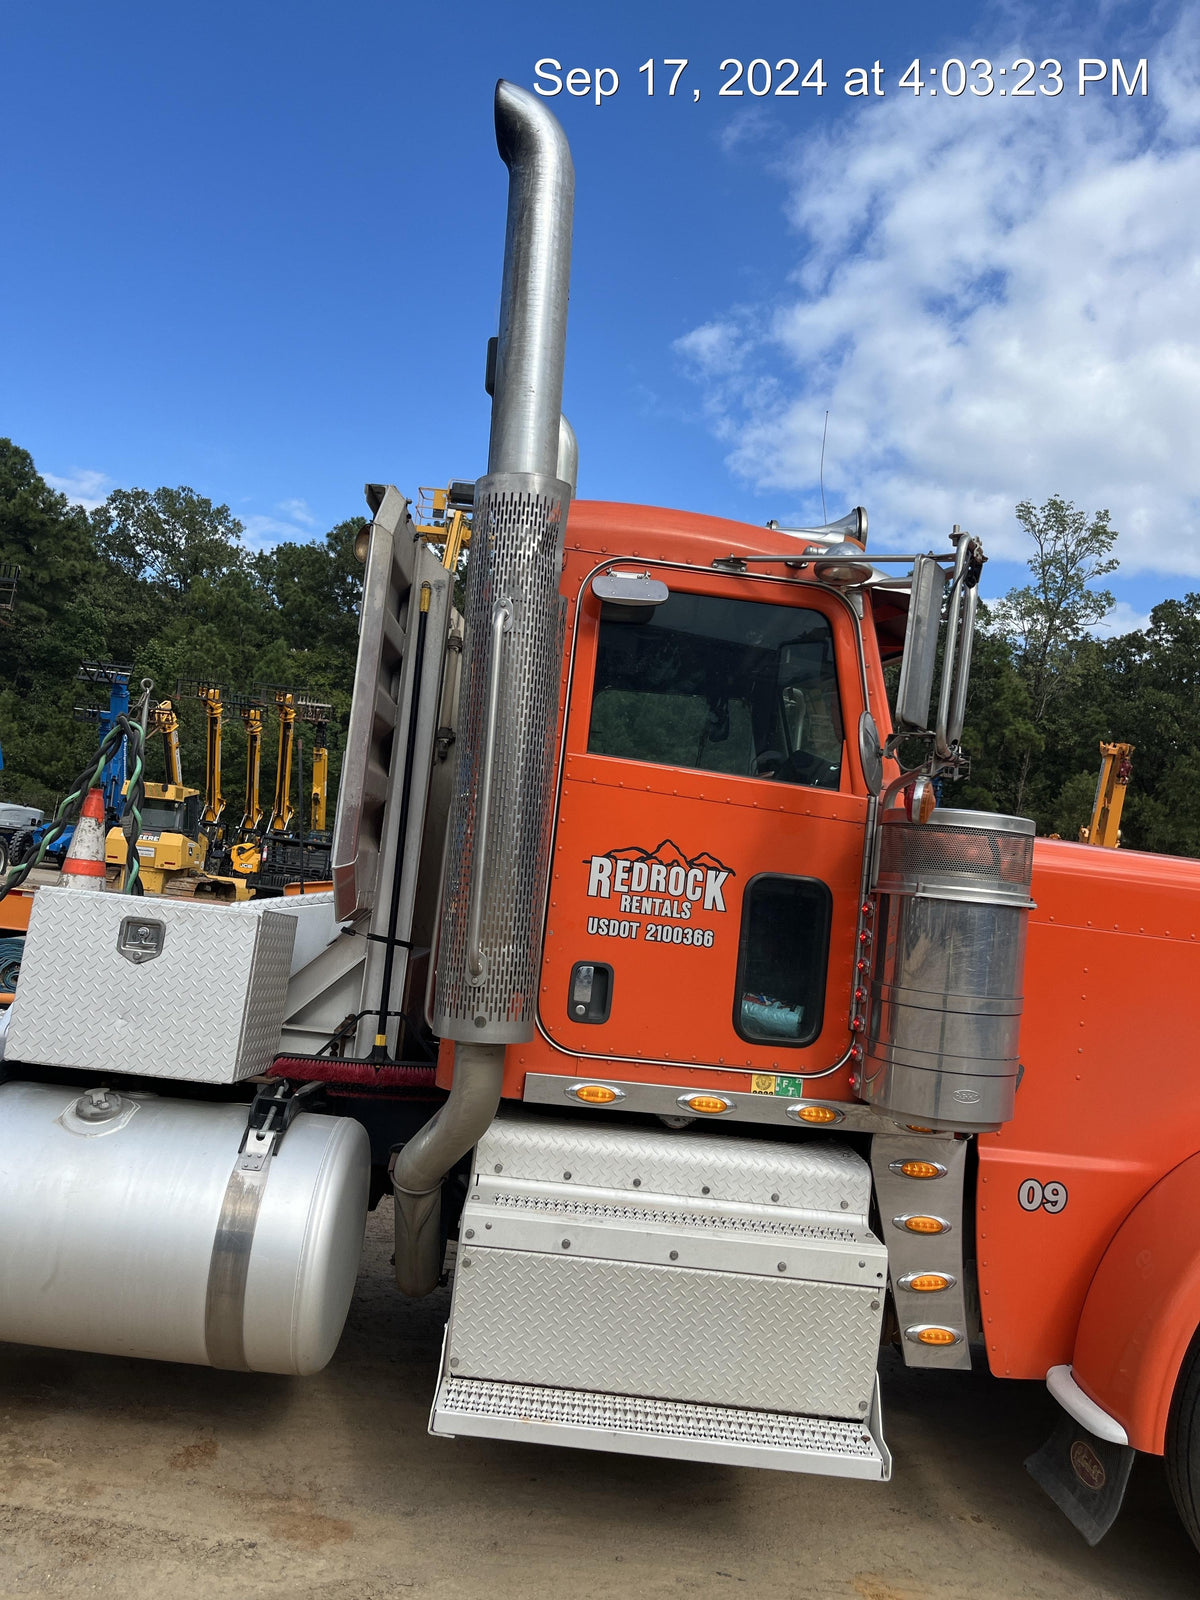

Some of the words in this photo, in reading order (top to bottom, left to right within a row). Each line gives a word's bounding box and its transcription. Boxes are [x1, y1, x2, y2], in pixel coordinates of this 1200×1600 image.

[587, 855, 728, 912] REDROCK
[620, 893, 692, 920] RENTALS
[587, 916, 640, 939] USDOT
[645, 923, 714, 948] 2100366
[1018, 1178, 1068, 1214] 09
